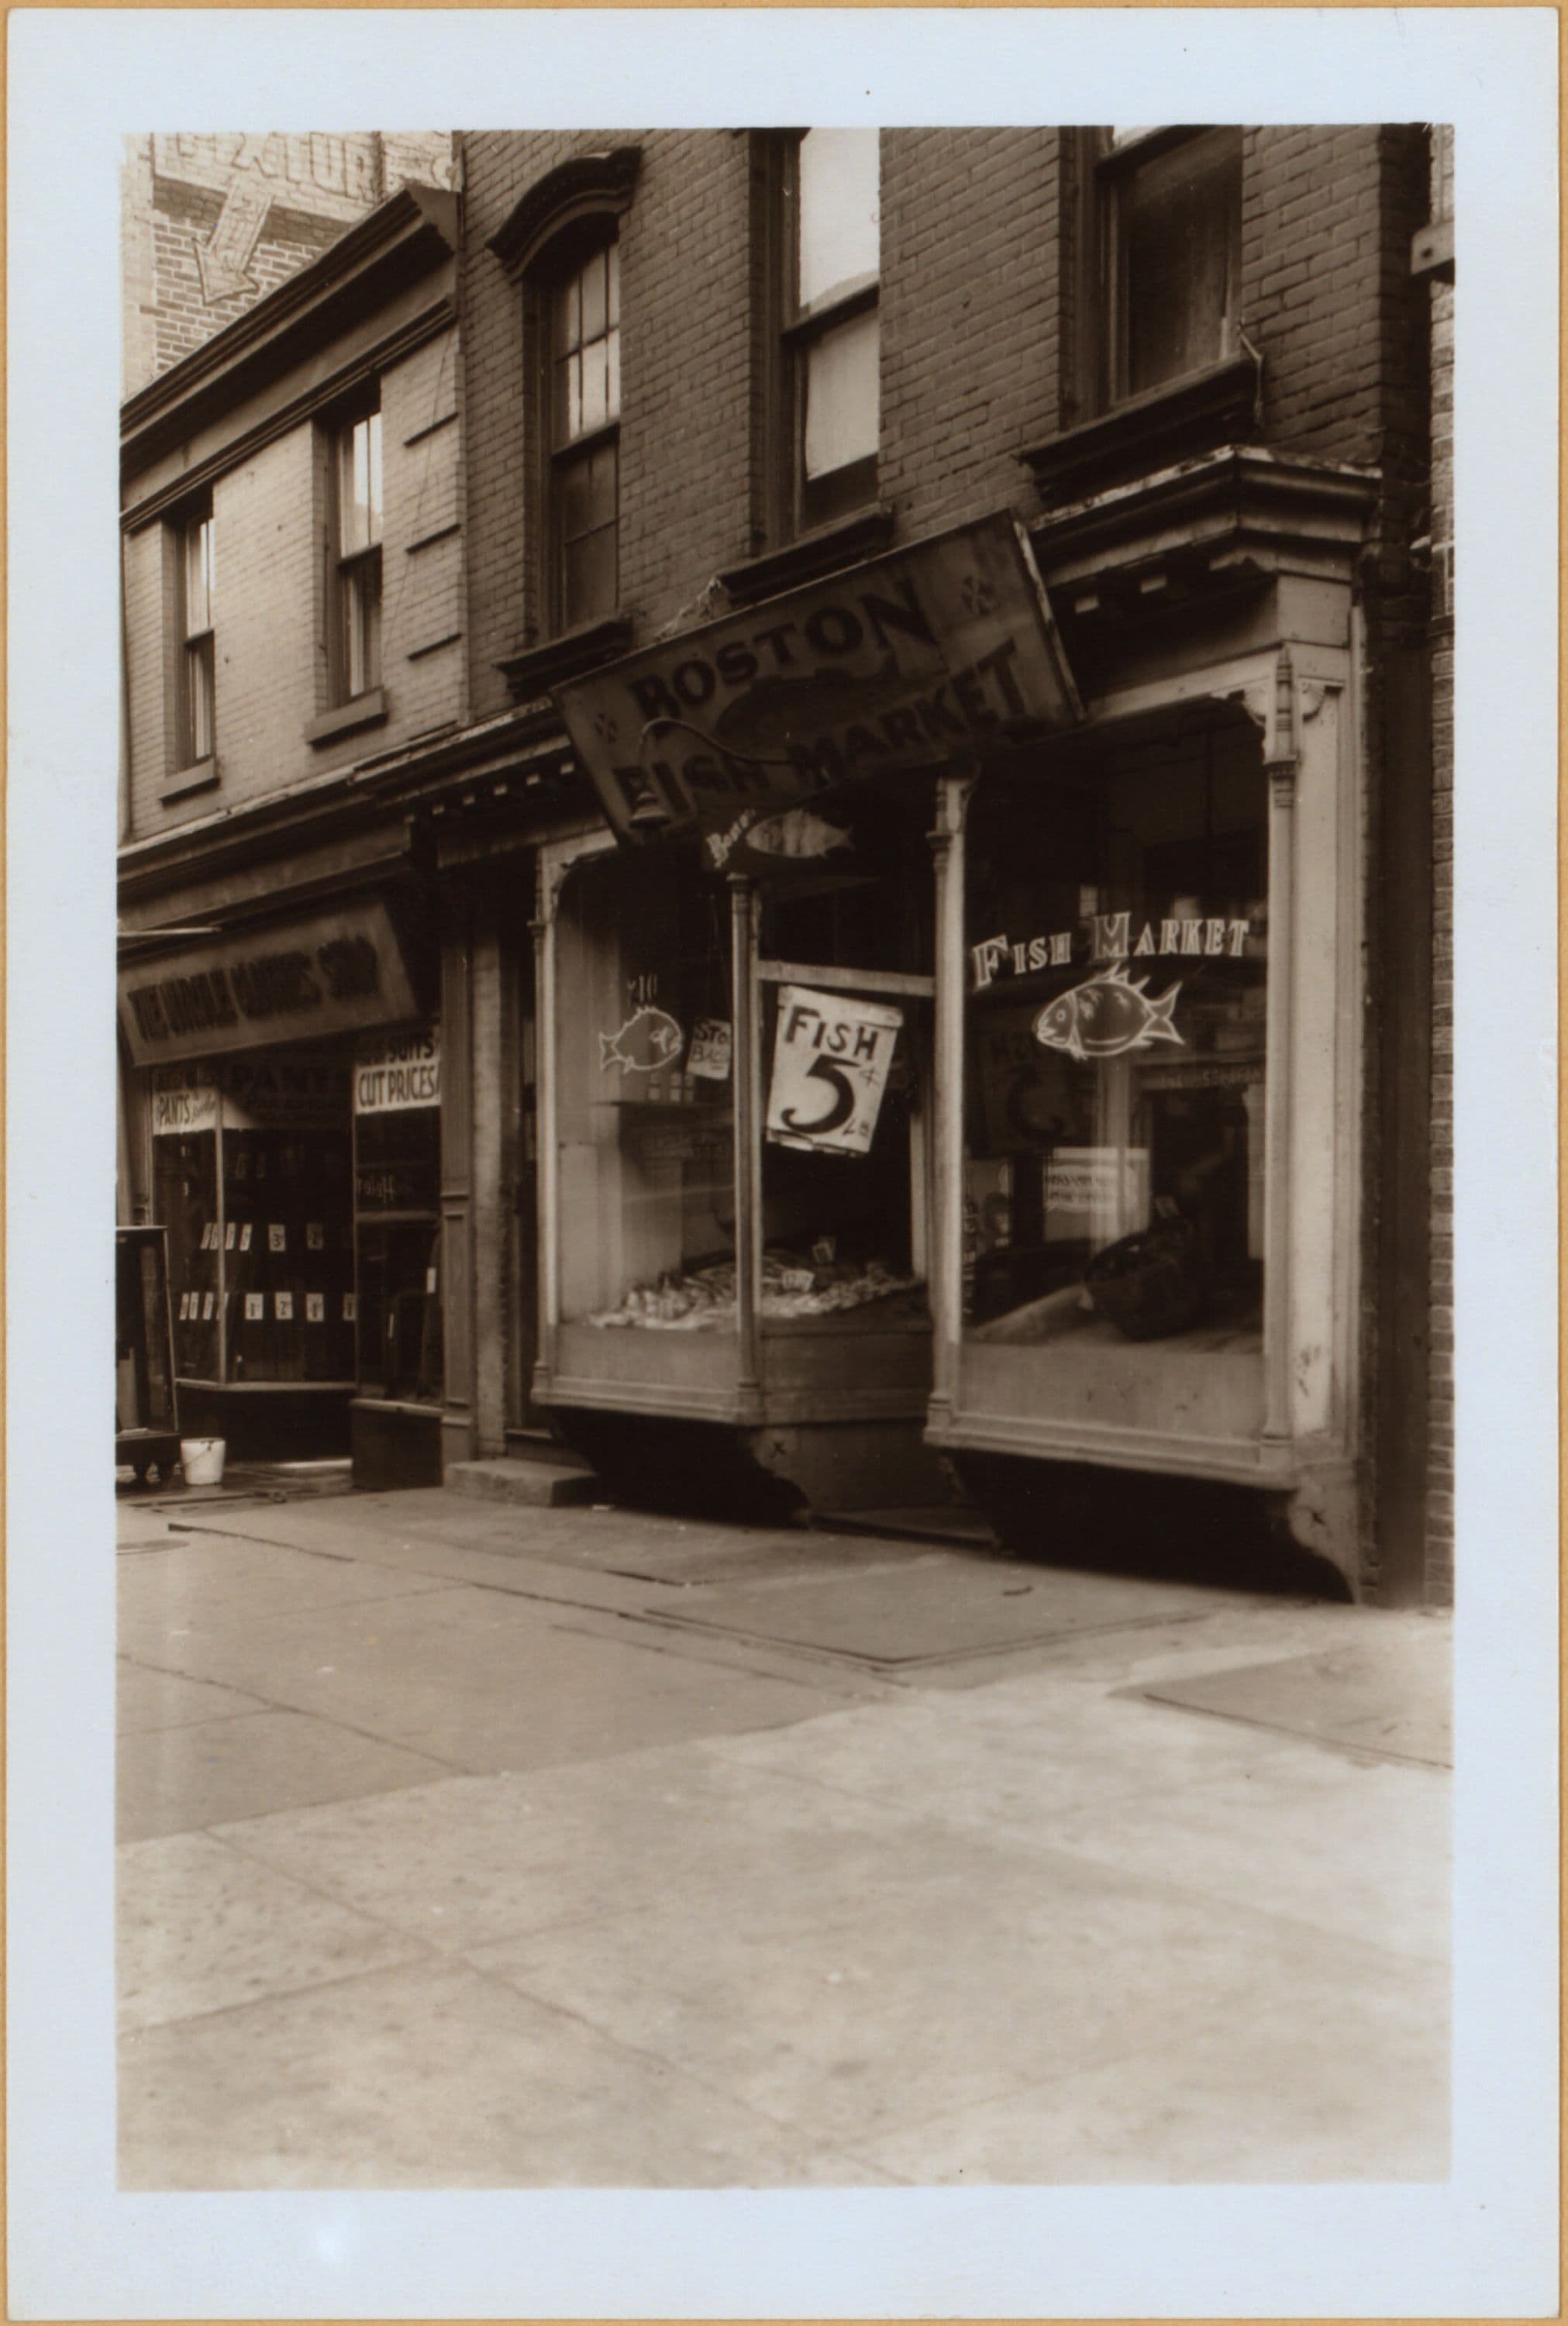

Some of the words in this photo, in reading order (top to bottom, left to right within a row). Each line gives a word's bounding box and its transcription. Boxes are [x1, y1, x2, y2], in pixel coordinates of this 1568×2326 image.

[626, 577, 941, 738] BOSTON
[785, 636, 1026, 788] MARKET
[1090, 911, 1250, 962] MARKET
[784, 1004, 879, 1062] FISH
[359, 1070, 385, 1107] CUT
[388, 1065, 435, 1102] PRICES
